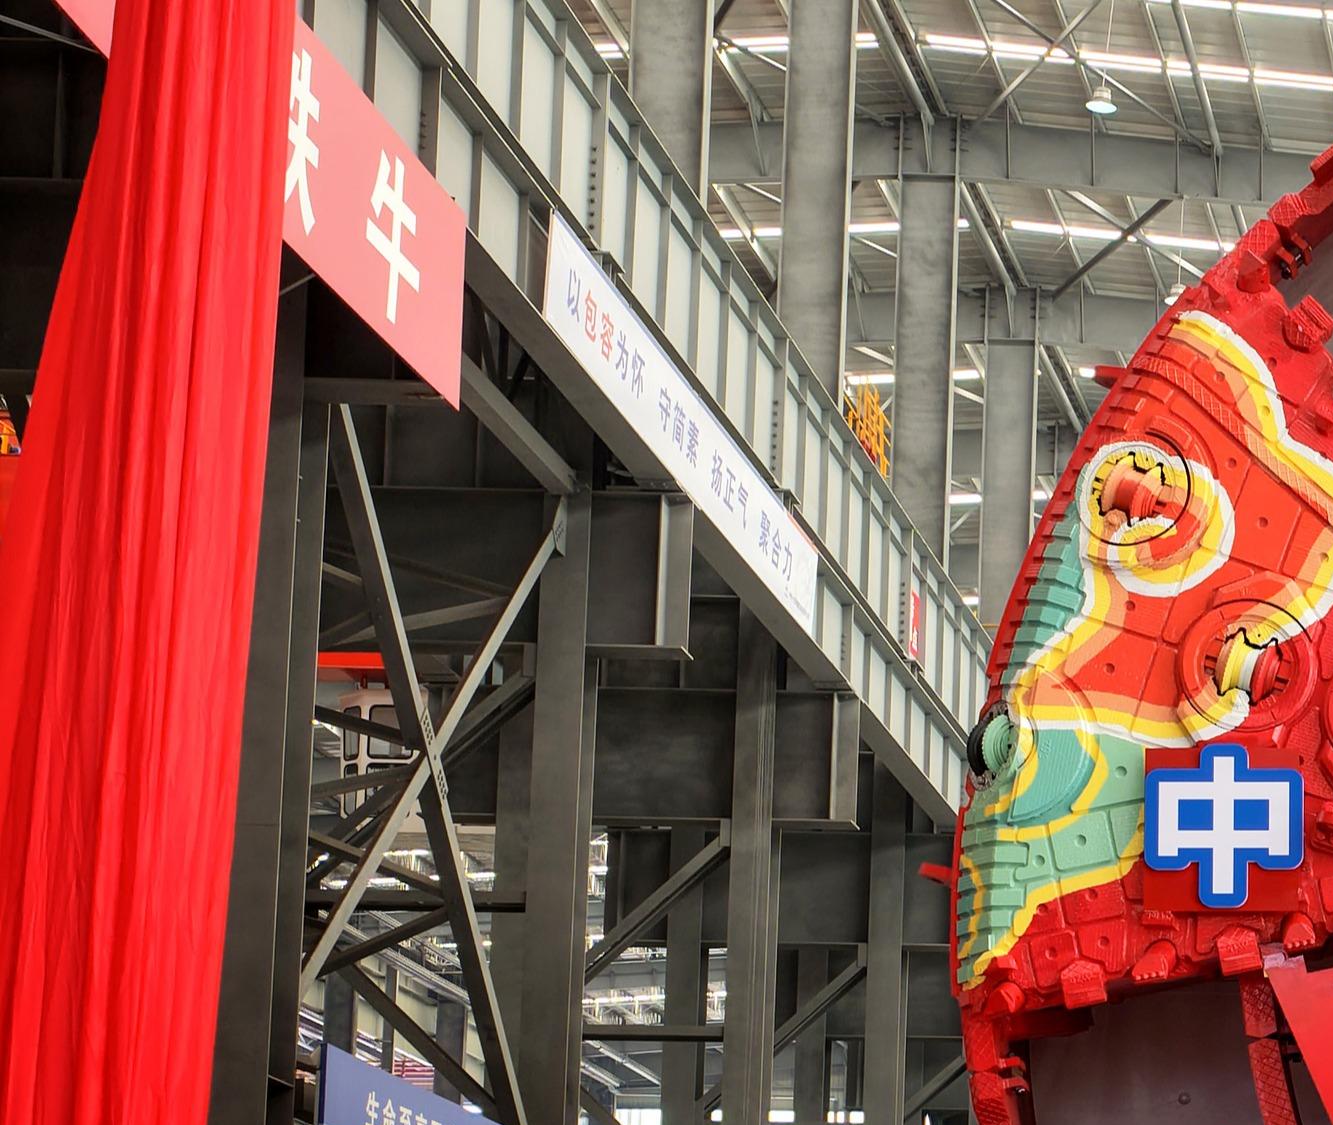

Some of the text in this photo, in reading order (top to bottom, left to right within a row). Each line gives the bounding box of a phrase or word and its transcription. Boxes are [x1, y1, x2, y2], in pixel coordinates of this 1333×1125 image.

[567, 268, 793, 582] 以包容为怀 守简素 扬正气 聚合力
[1157, 755, 1290, 895] 中
